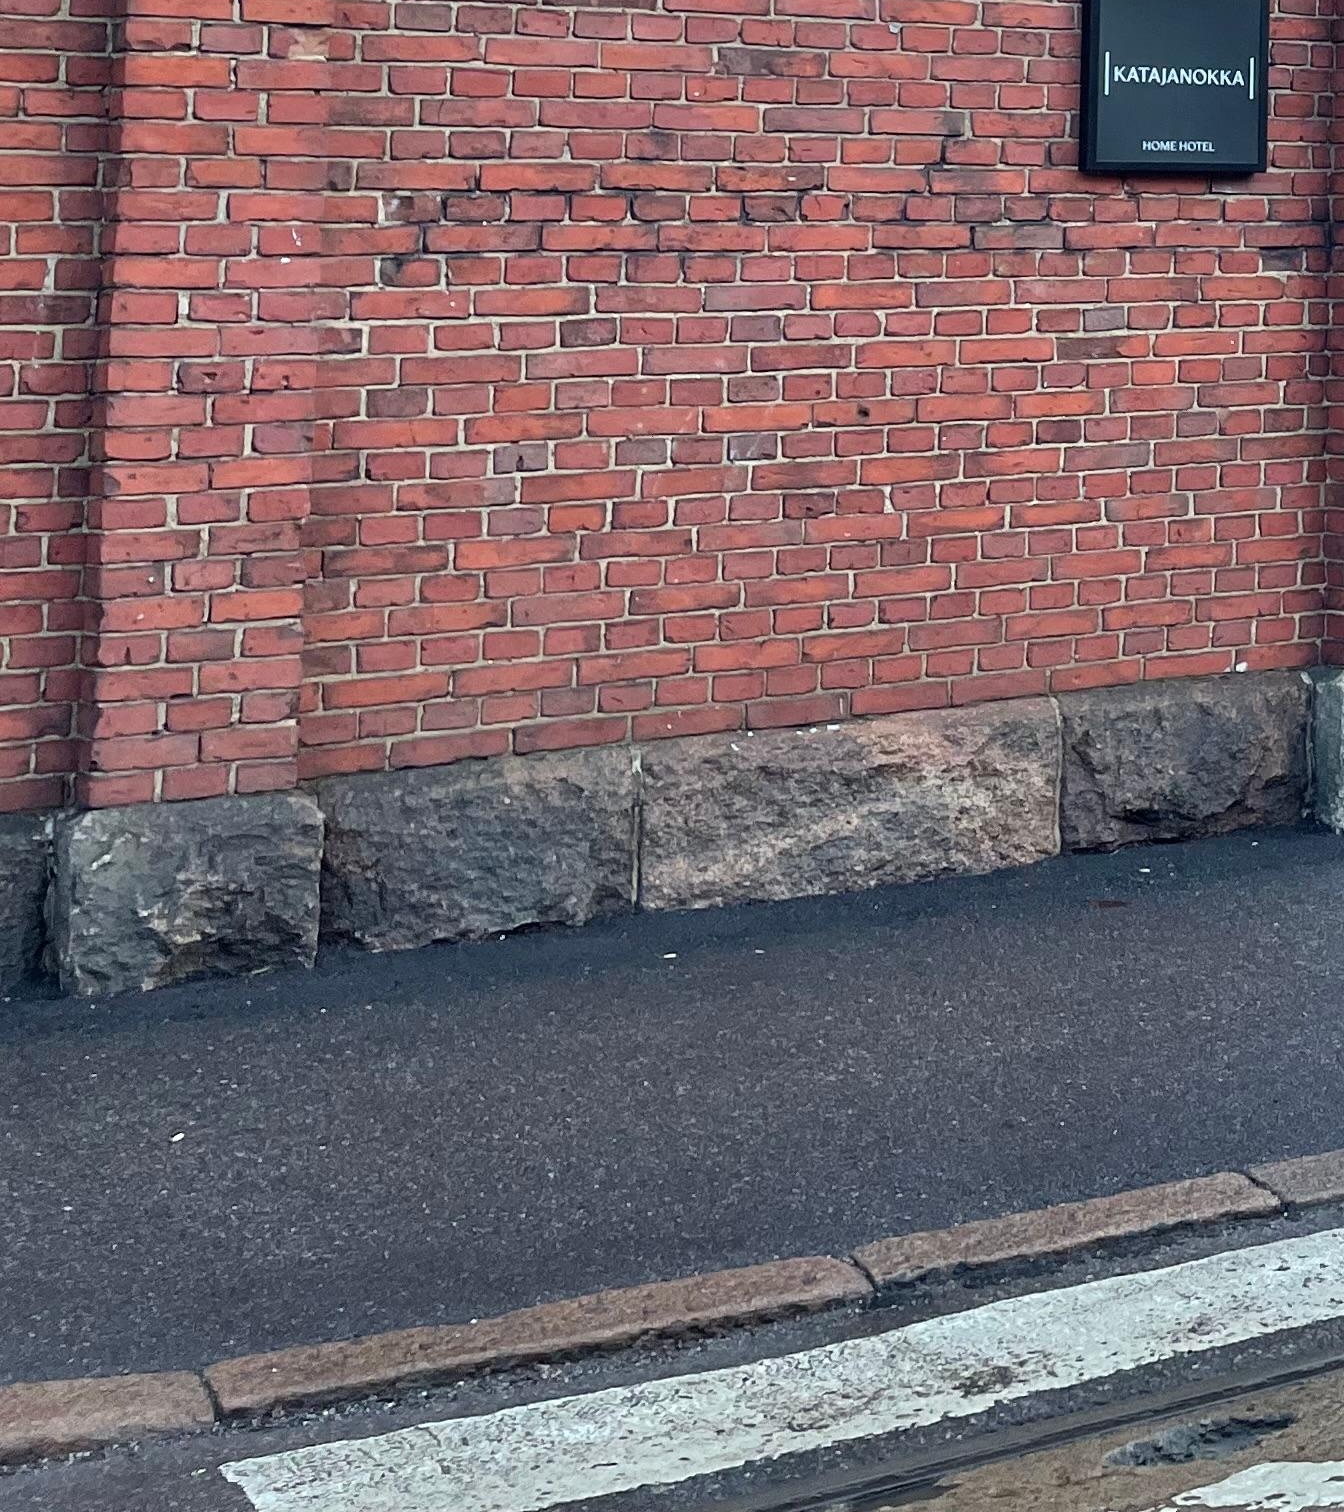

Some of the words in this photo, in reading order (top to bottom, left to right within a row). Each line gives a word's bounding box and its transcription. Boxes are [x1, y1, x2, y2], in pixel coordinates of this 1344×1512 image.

[1113, 66, 1245, 87] KATAJANOKKA
[1142, 140, 1177, 151] HOME
[1178, 141, 1216, 152] HOTEL
